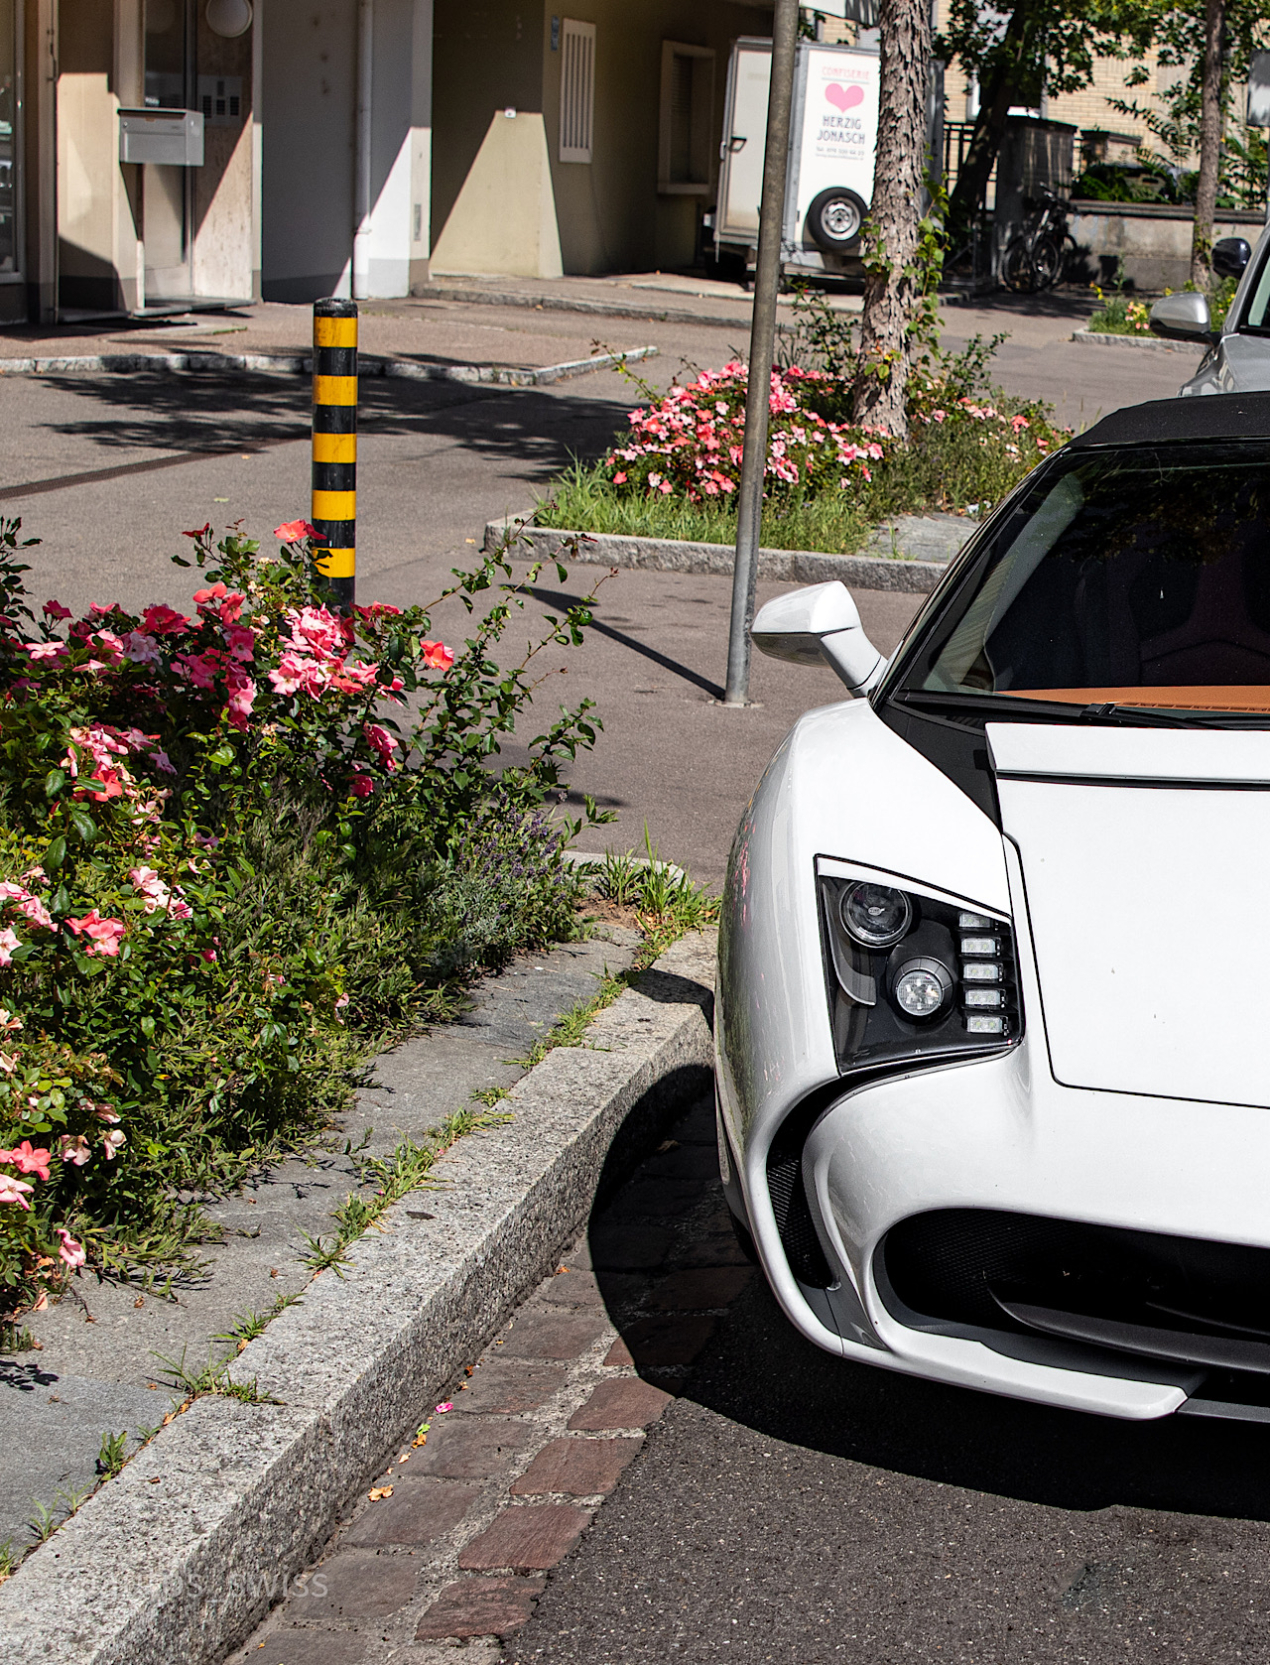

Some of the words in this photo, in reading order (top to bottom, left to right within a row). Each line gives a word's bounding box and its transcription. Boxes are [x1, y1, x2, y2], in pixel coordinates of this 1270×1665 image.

[822, 66, 870, 80] CONFISERIE
[822, 115, 861, 130] HERZIG
[817, 130, 866, 145] JONASCH
